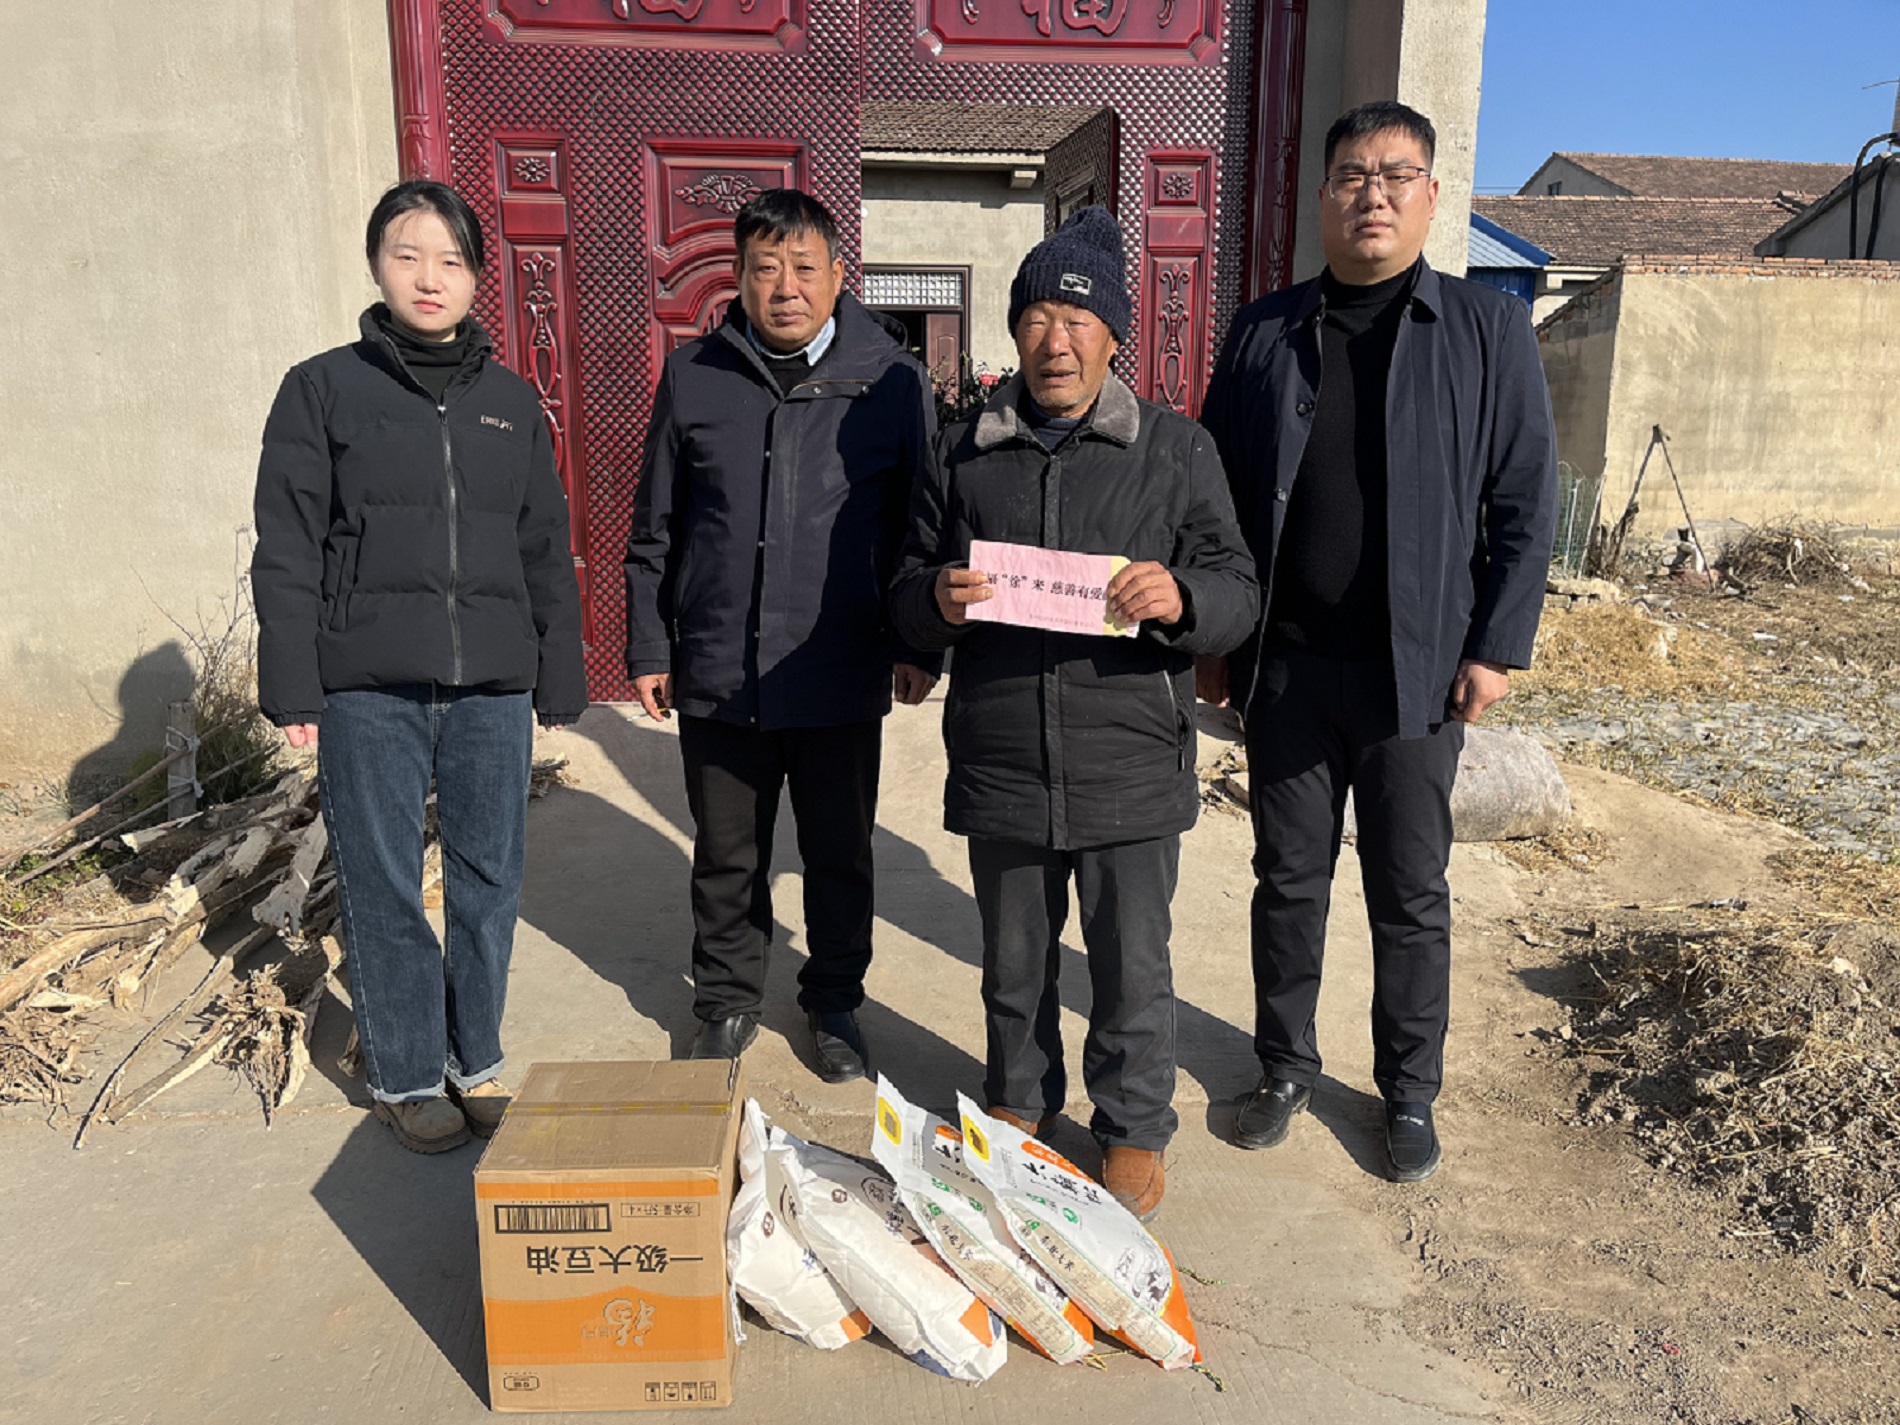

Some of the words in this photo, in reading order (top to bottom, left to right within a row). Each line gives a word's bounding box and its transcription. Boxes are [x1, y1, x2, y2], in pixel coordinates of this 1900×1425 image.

[1050, 580, 1108, 600] 慈善有爱
[526, 1244, 704, 1275] 一级大豆油
